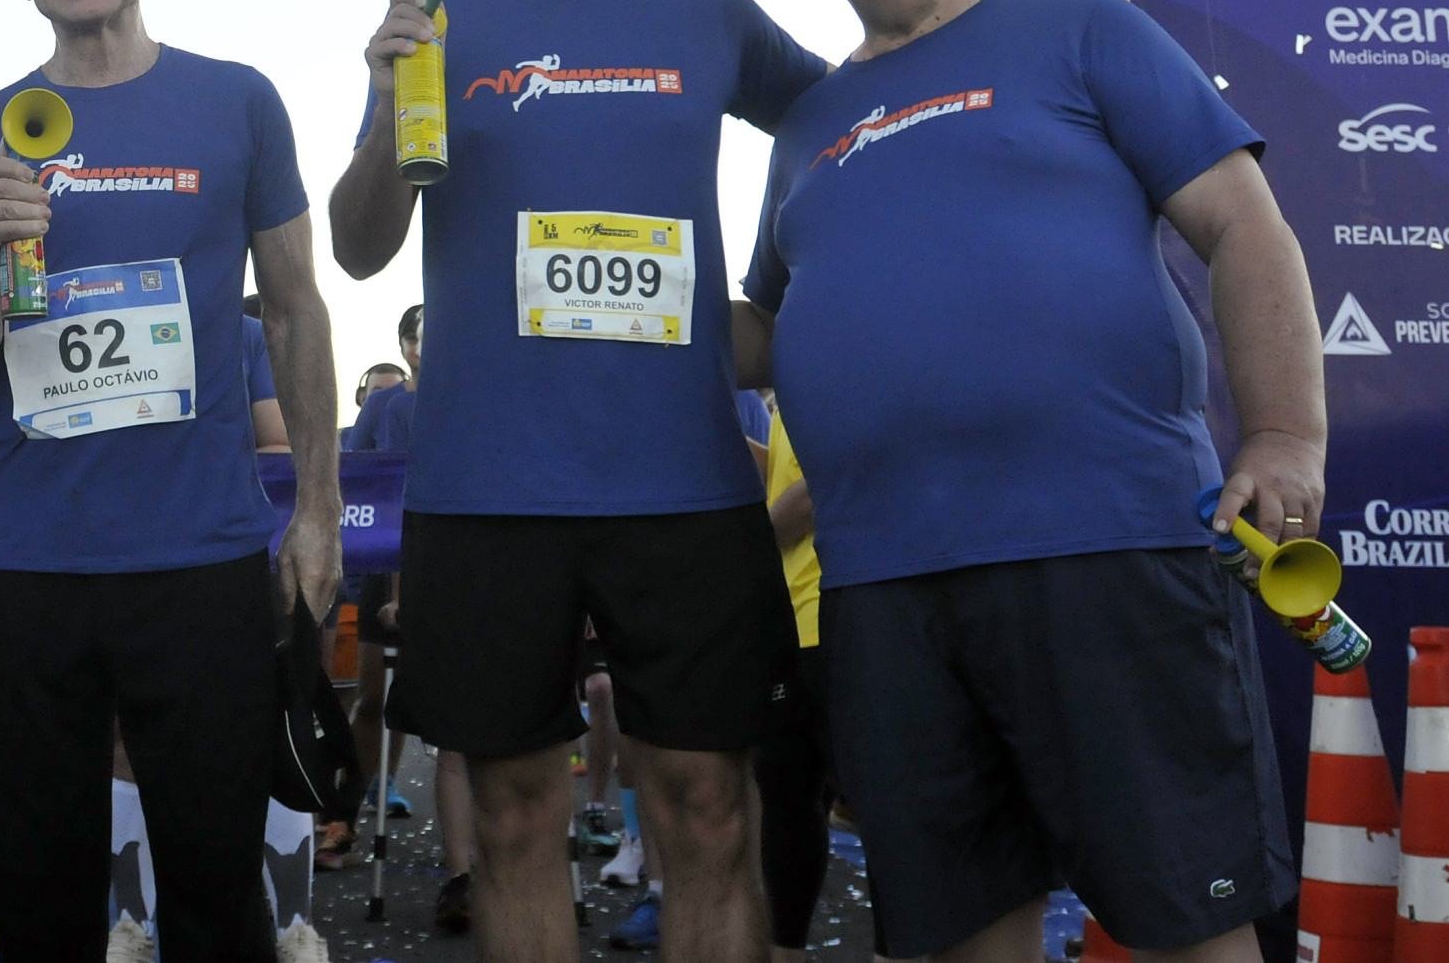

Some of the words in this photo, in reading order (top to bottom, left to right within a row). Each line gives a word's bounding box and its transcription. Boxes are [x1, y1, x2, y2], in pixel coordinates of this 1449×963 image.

[1330, 49, 1409, 65] Medicina
[551, 68, 656, 80] MARATONA
[549, 79, 657, 94] BRASÍLIA
[72, 167, 174, 179] MARATONA
[70, 178, 174, 192] BRASÍLIA
[546, 254, 662, 298] 6099
[564, 299, 601, 309] VICTOR
[604, 301, 645, 311] RENATO
[59, 318, 130, 373] 62
[43, 379, 89, 398] PAULO
[93, 369, 159, 389] OCTÁVIO
[339, 504, 375, 527] RB
